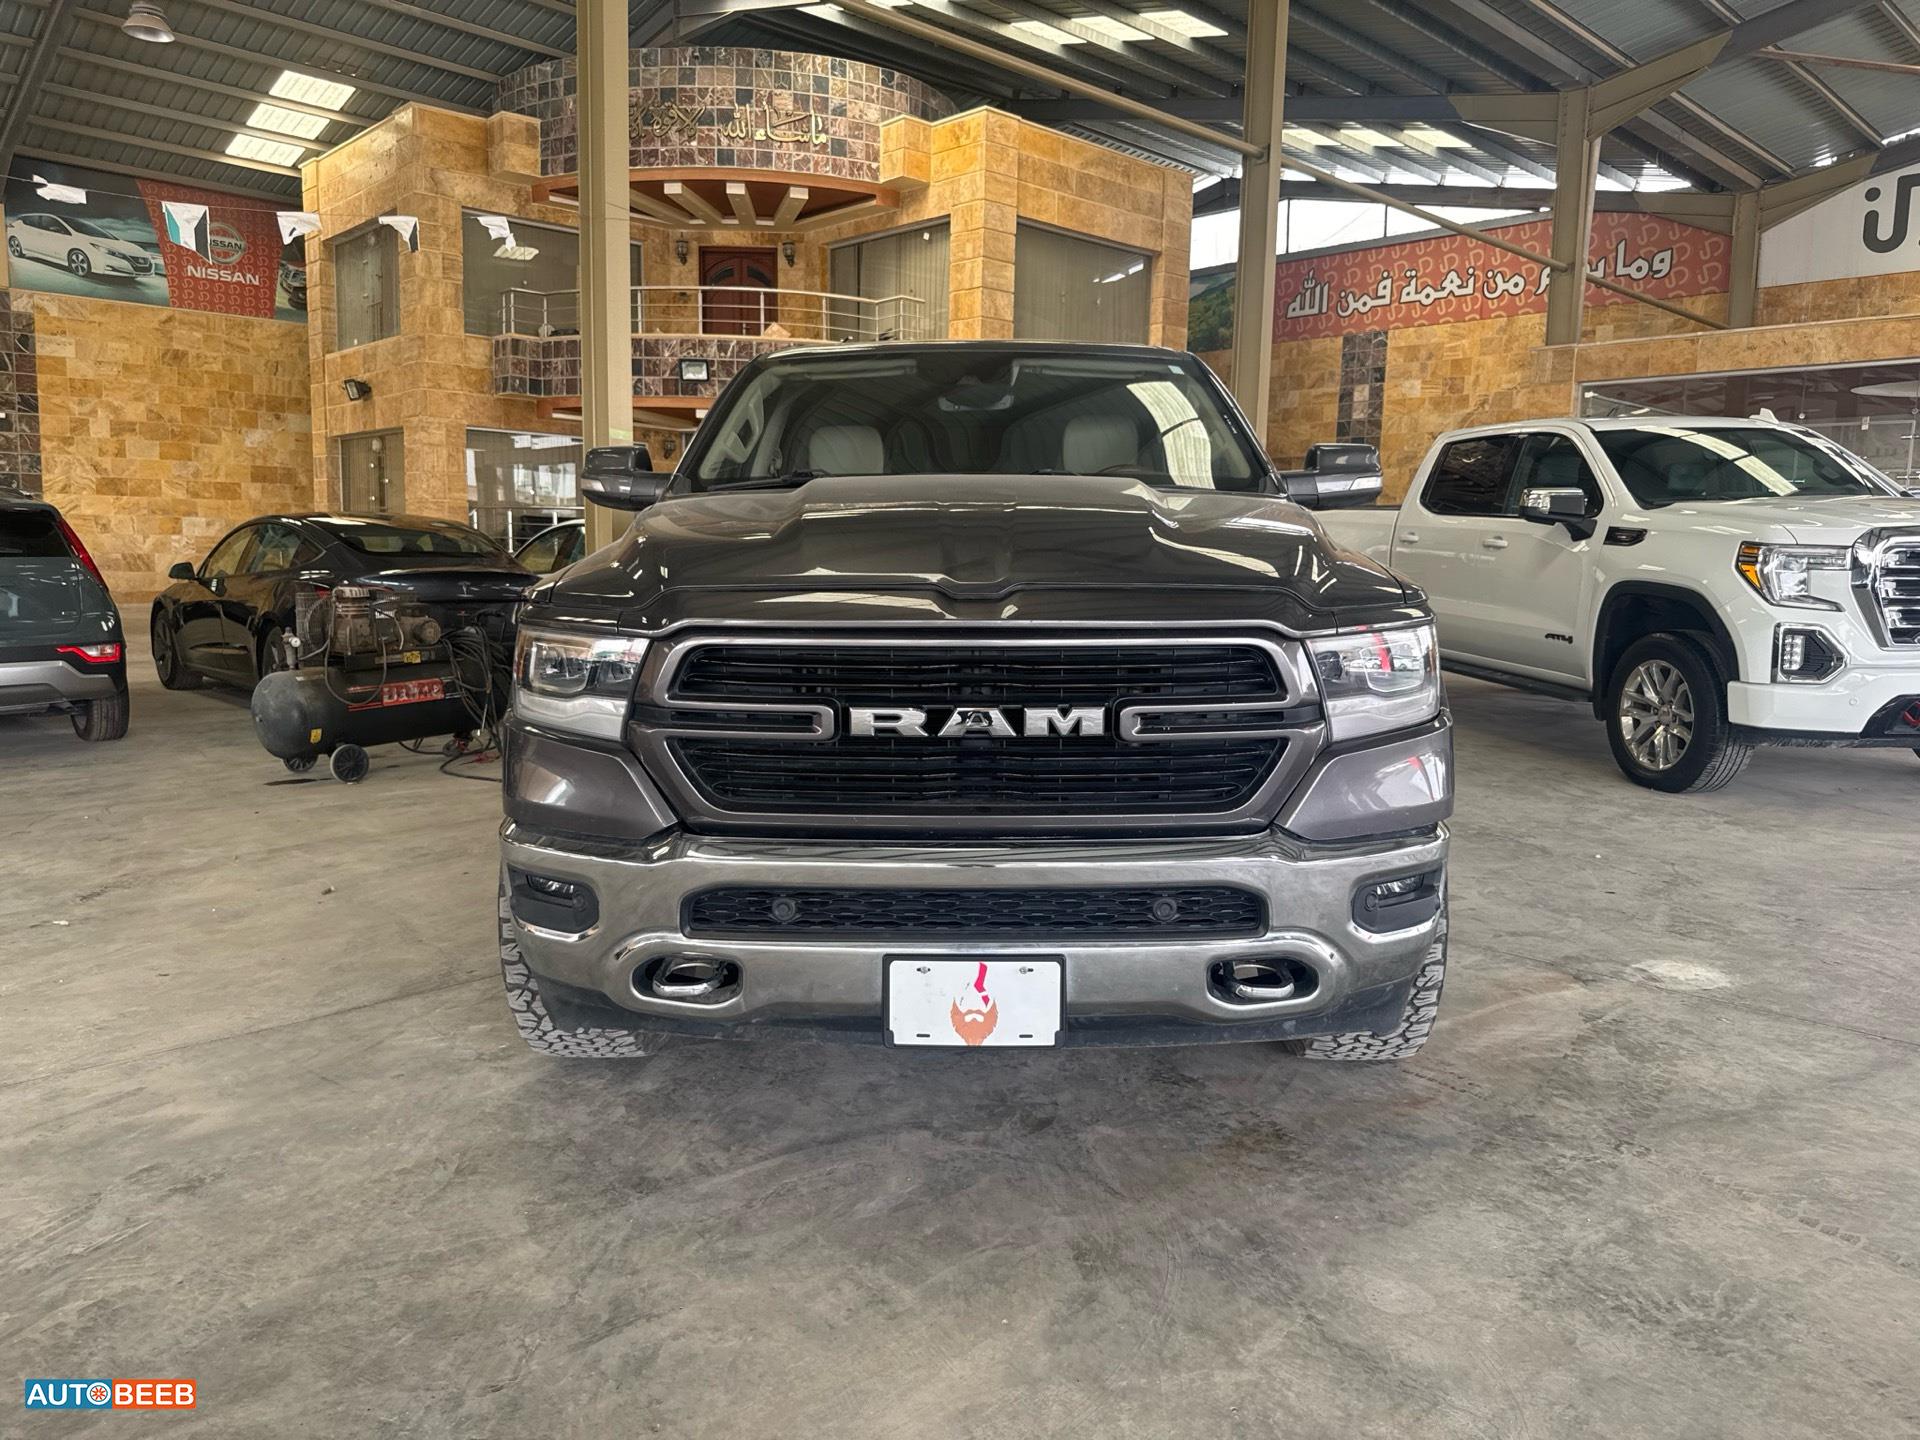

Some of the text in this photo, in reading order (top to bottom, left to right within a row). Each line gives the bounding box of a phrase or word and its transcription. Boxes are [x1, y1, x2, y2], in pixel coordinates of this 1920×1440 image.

[209, 238, 242, 250] ISSAN
[1615, 239, 1673, 281] وما
[186, 264, 260, 286] NISSAN
[1286, 267, 1329, 319] الله
[1399, 265, 1475, 307] نعمة
[1482, 270, 1526, 300] من
[1336, 269, 1393, 318] فمن
[849, 706, 1106, 737] RAM
